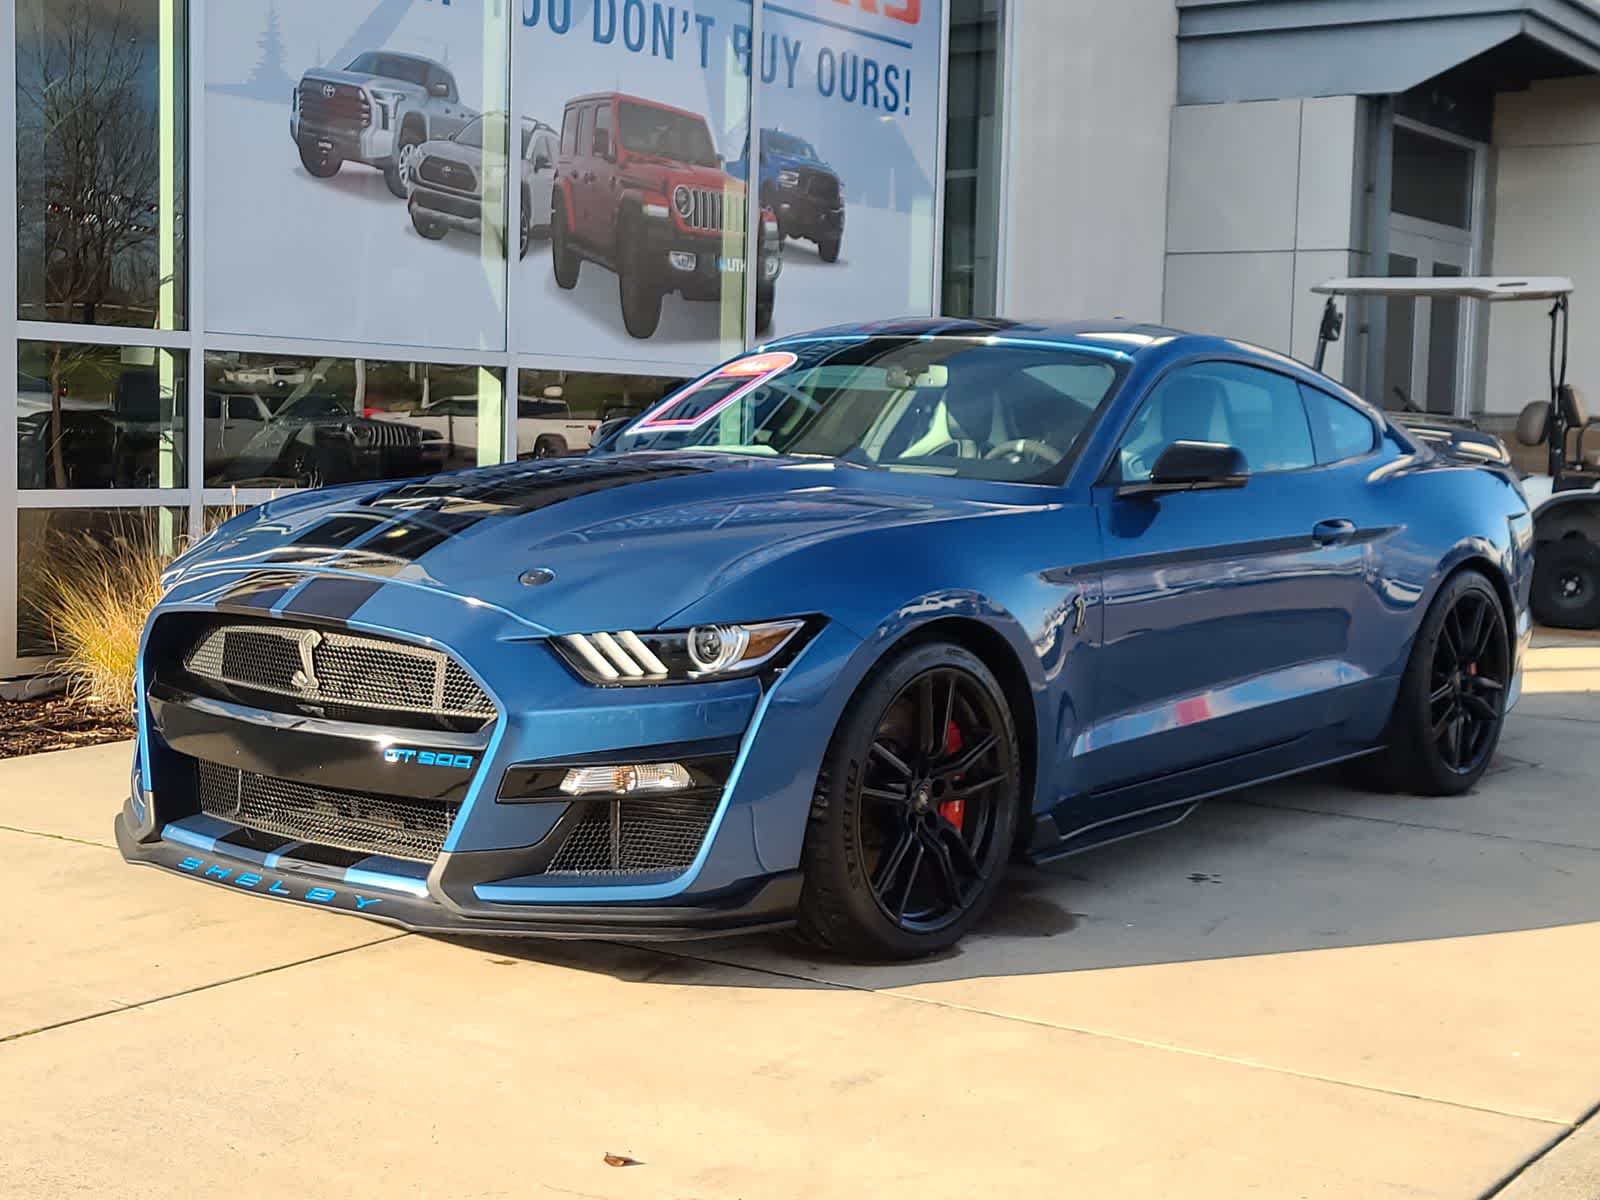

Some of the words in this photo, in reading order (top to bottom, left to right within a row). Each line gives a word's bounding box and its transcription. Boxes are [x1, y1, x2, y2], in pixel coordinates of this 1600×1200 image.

[593, 0, 715, 69] DON'T
[733, 34, 801, 88] BUY
[817, 47, 910, 115] OURS!
[178, 857, 383, 909] SHELBY
